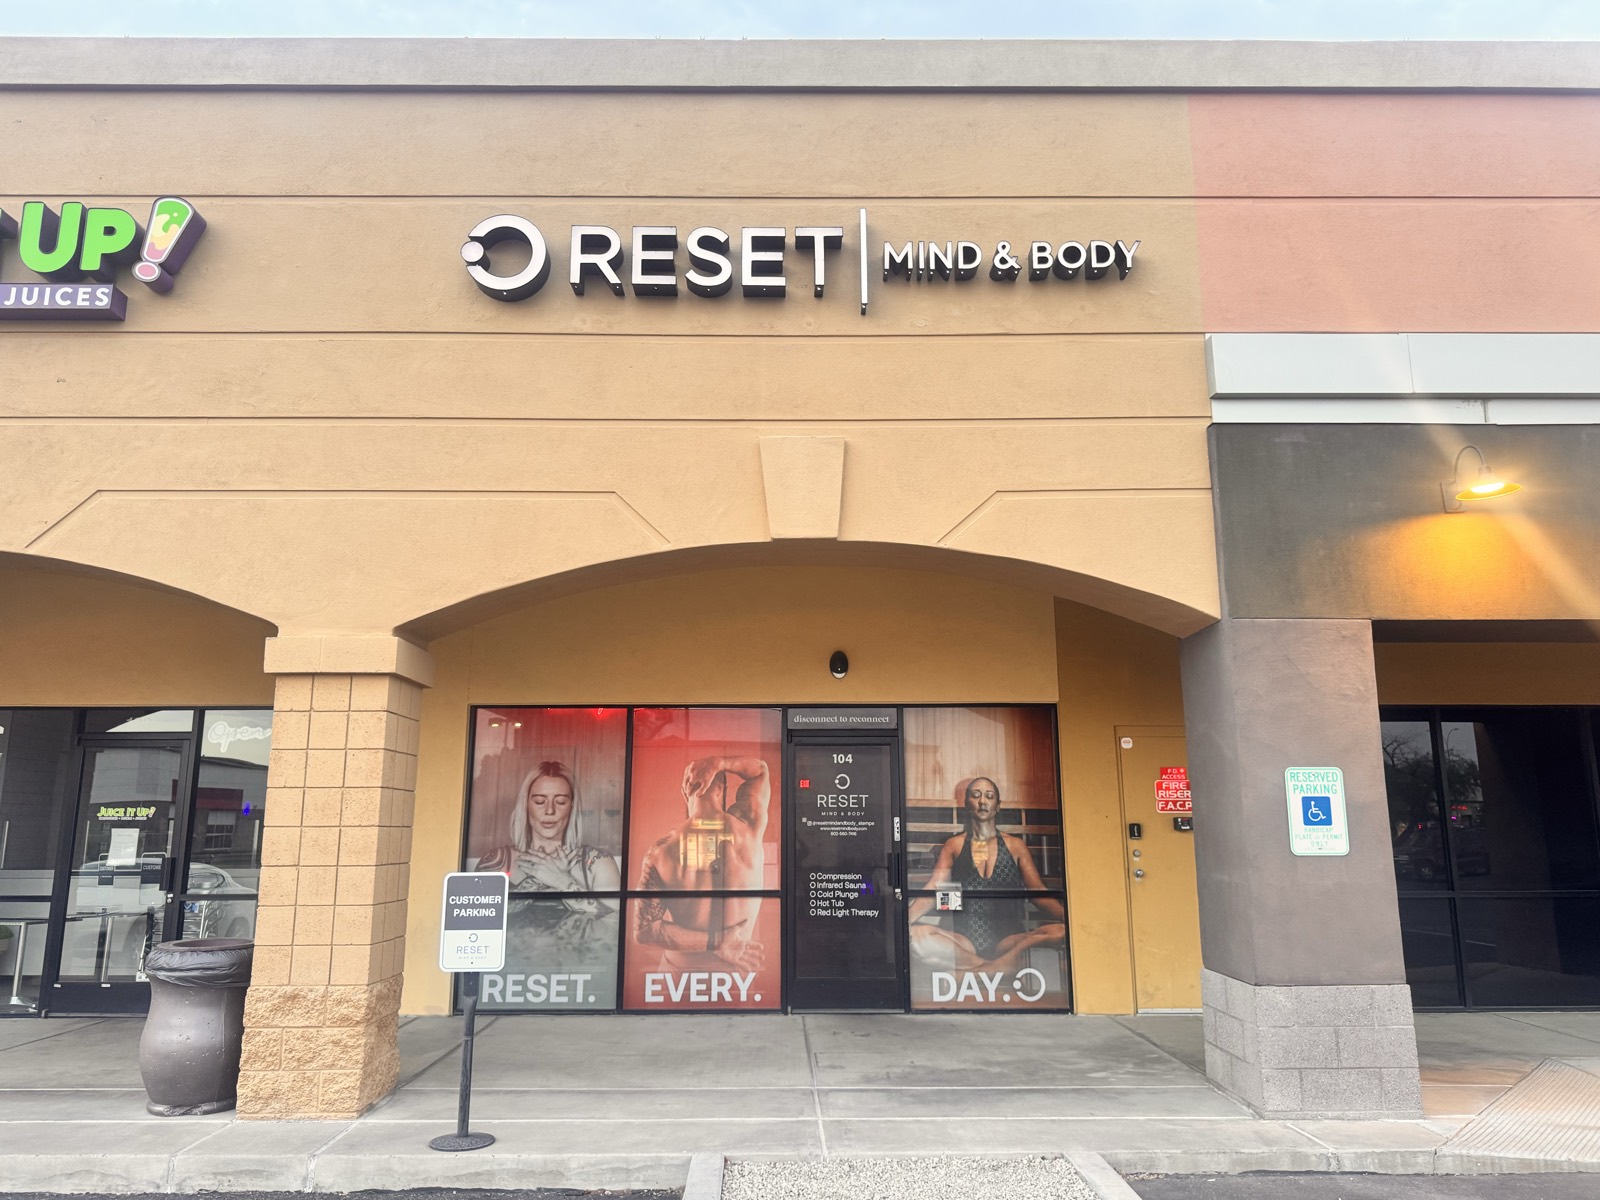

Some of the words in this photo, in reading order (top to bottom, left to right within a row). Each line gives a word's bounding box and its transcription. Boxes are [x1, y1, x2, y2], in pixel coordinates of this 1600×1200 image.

[570, 225, 843, 288] RESET
[883, 241, 983, 272] MIND
[993, 240, 1022, 272] &
[1031, 240, 1141, 272] BODY
[3, 286, 111, 306] JUICES
[793, 715, 838, 723] disconnect
[849, 715, 890, 723] reconnect
[207, 720, 273, 753] Open
[832, 753, 853, 764] 104
[1289, 771, 1339, 782] RESERVED
[1162, 782, 1188, 790] FIRE
[1292, 784, 1338, 794] PARKING
[1158, 790, 1192, 798] RISER
[817, 794, 869, 808] RESET
[96, 806, 125, 816] JUICE
[126, 807, 136, 816] IT
[816, 872, 862, 881] Compression
[835, 890, 858, 899] Plunge
[449, 895, 502, 905] CUSTOMER
[453, 908, 496, 917] PARKING
[832, 909, 849, 917] Light
[851, 909, 879, 917] Therapy
[456, 946, 489, 955] RESET
[482, 974, 596, 1003] RESET.
[645, 972, 762, 1002] EVERY.
[932, 972, 1010, 1002] DAY.
